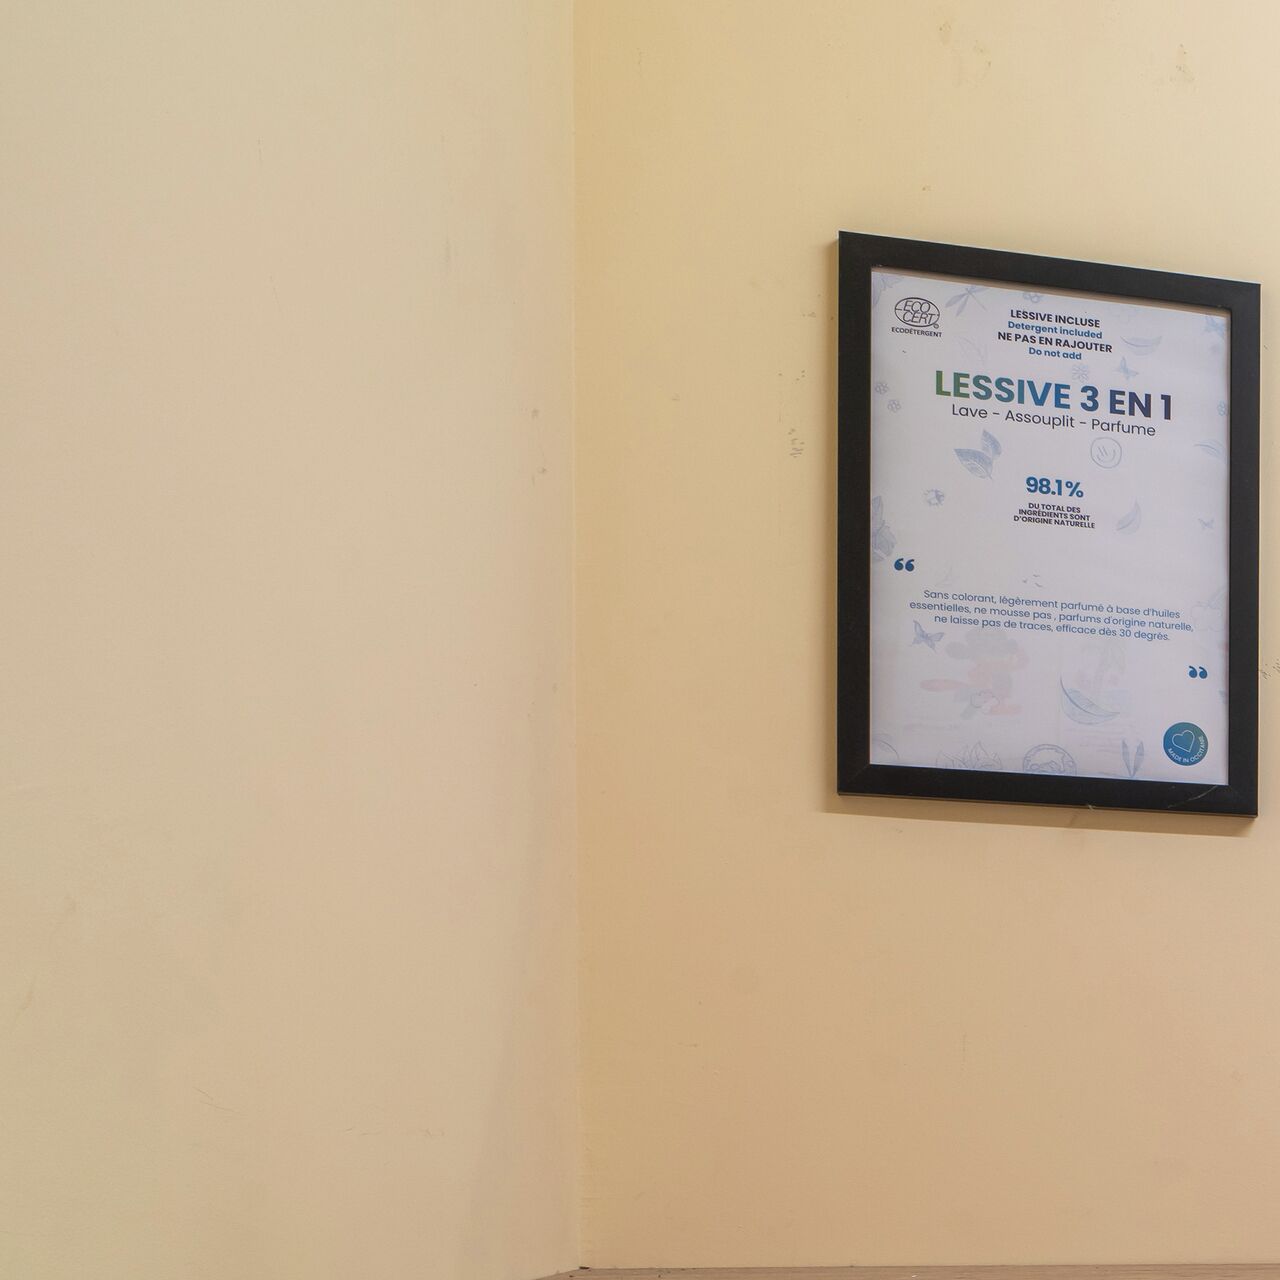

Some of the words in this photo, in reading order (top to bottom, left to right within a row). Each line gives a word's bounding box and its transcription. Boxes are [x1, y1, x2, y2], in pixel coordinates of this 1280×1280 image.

[903, 300, 930, 313] ECO
[902, 309, 936, 324] CERT
[1011, 309, 1052, 322] LESSIVE
[1055, 314, 1100, 328] INCLUSE
[891, 326, 943, 338] ECODÉTERGENT
[1008, 320, 1057, 334] Detergent
[1060, 326, 1102, 339] included
[998, 331, 1012, 341] NE
[1015, 333, 1036, 343] PAS
[1039, 335, 1052, 345] EN
[1056, 337, 1112, 352] RAJOUTER
[1029, 346, 1042, 355] Do
[1062, 351, 1081, 360] add
[936, 370, 1070, 409] LESSIVE
[1081, 385, 1099, 411] 3
[1110, 389, 1151, 418] EN
[1161, 393, 1171, 420] 1
[952, 403, 987, 418] Lave
[1005, 409, 1074, 429] Assouplit
[1091, 422, 1156, 437] Parfume
[1026, 476, 1083, 497] 98.1%
[1018, 508, 1068, 520] INGRÉDIENTS
[1069, 513, 1090, 521] SONT
[1028, 502, 1040, 510] DU
[1041, 503, 1065, 512] TOTAL
[1066, 506, 1081, 514] DES
[1013, 515, 1053, 525] D'ORIGINE
[1054, 518, 1096, 529] NATURELLE
[924, 589, 949, 601] Sans
[952, 592, 997, 605] colorant,
[1000, 594, 1058, 608] légèrement
[1061, 601, 1104, 614] parfumé
[1106, 604, 1113, 613] à
[1116, 605, 1140, 616] base
[1143, 607, 1180, 618] d'huiles
